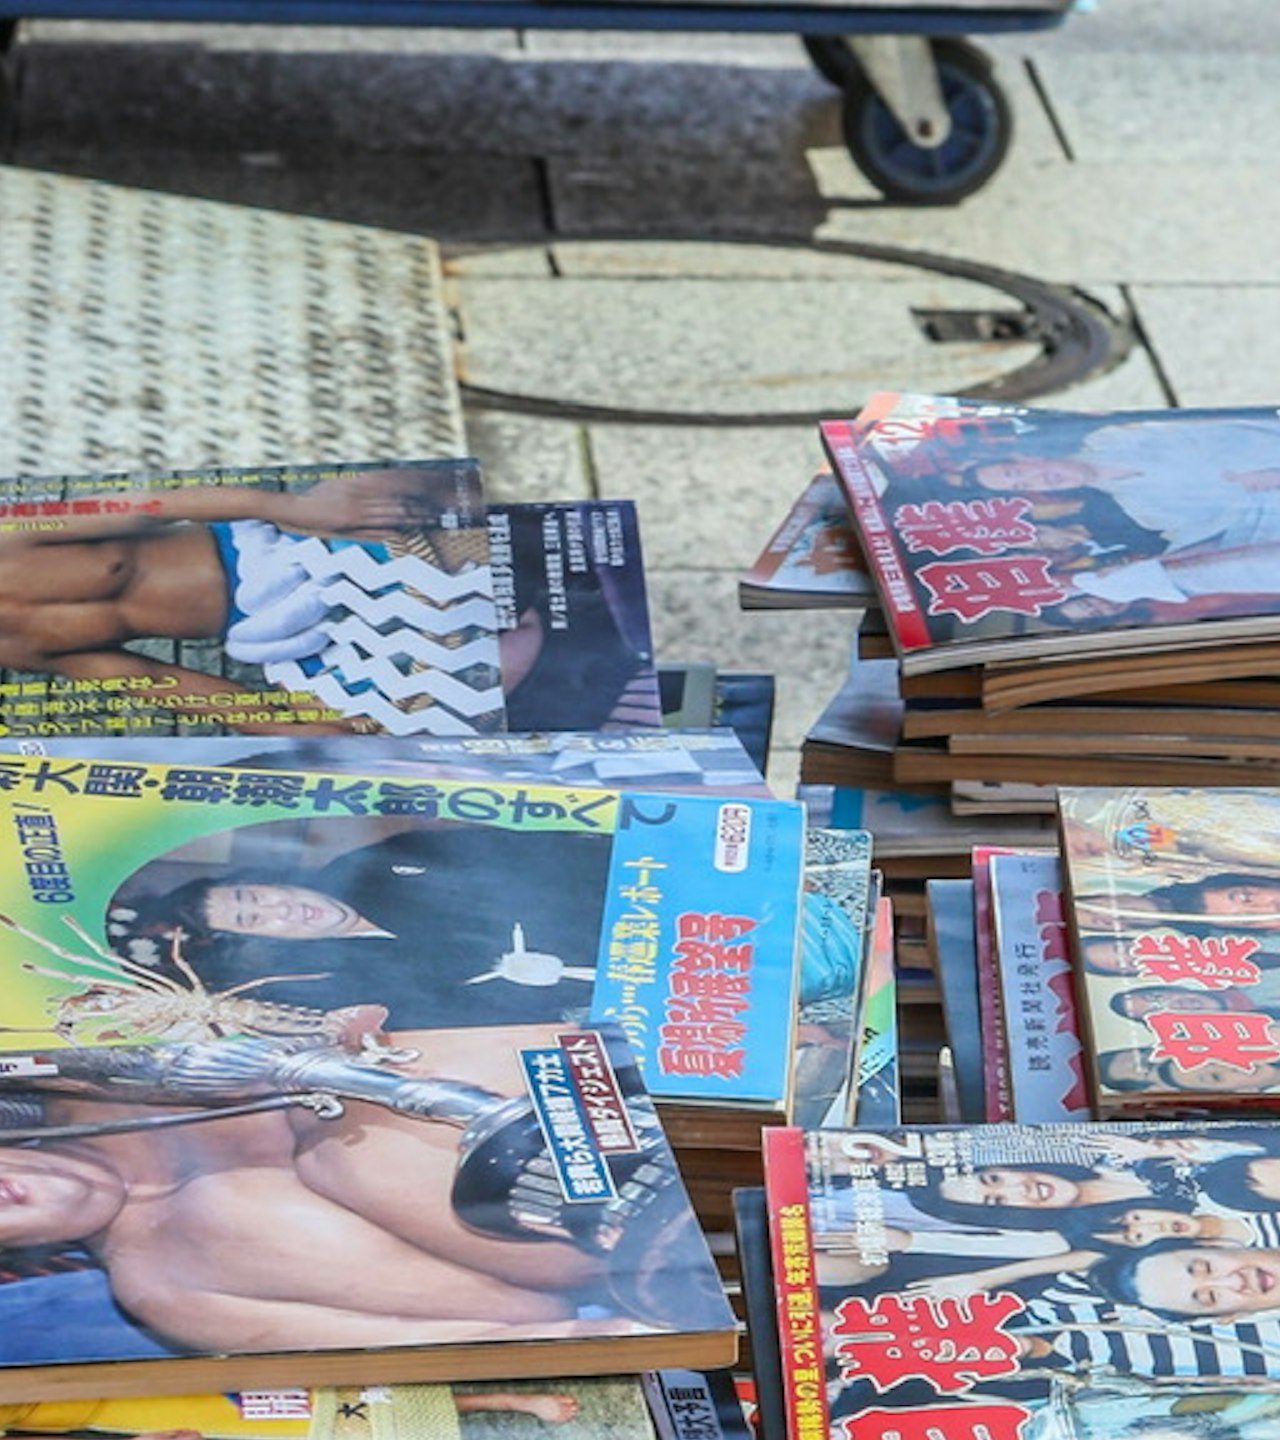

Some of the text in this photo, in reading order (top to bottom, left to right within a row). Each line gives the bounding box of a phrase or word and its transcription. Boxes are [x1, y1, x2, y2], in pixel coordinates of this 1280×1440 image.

[893, 494, 1070, 626] 相撲
[658, 910, 760, 1081] 夏場所展望号
[842, 1128, 926, 1161] 2
